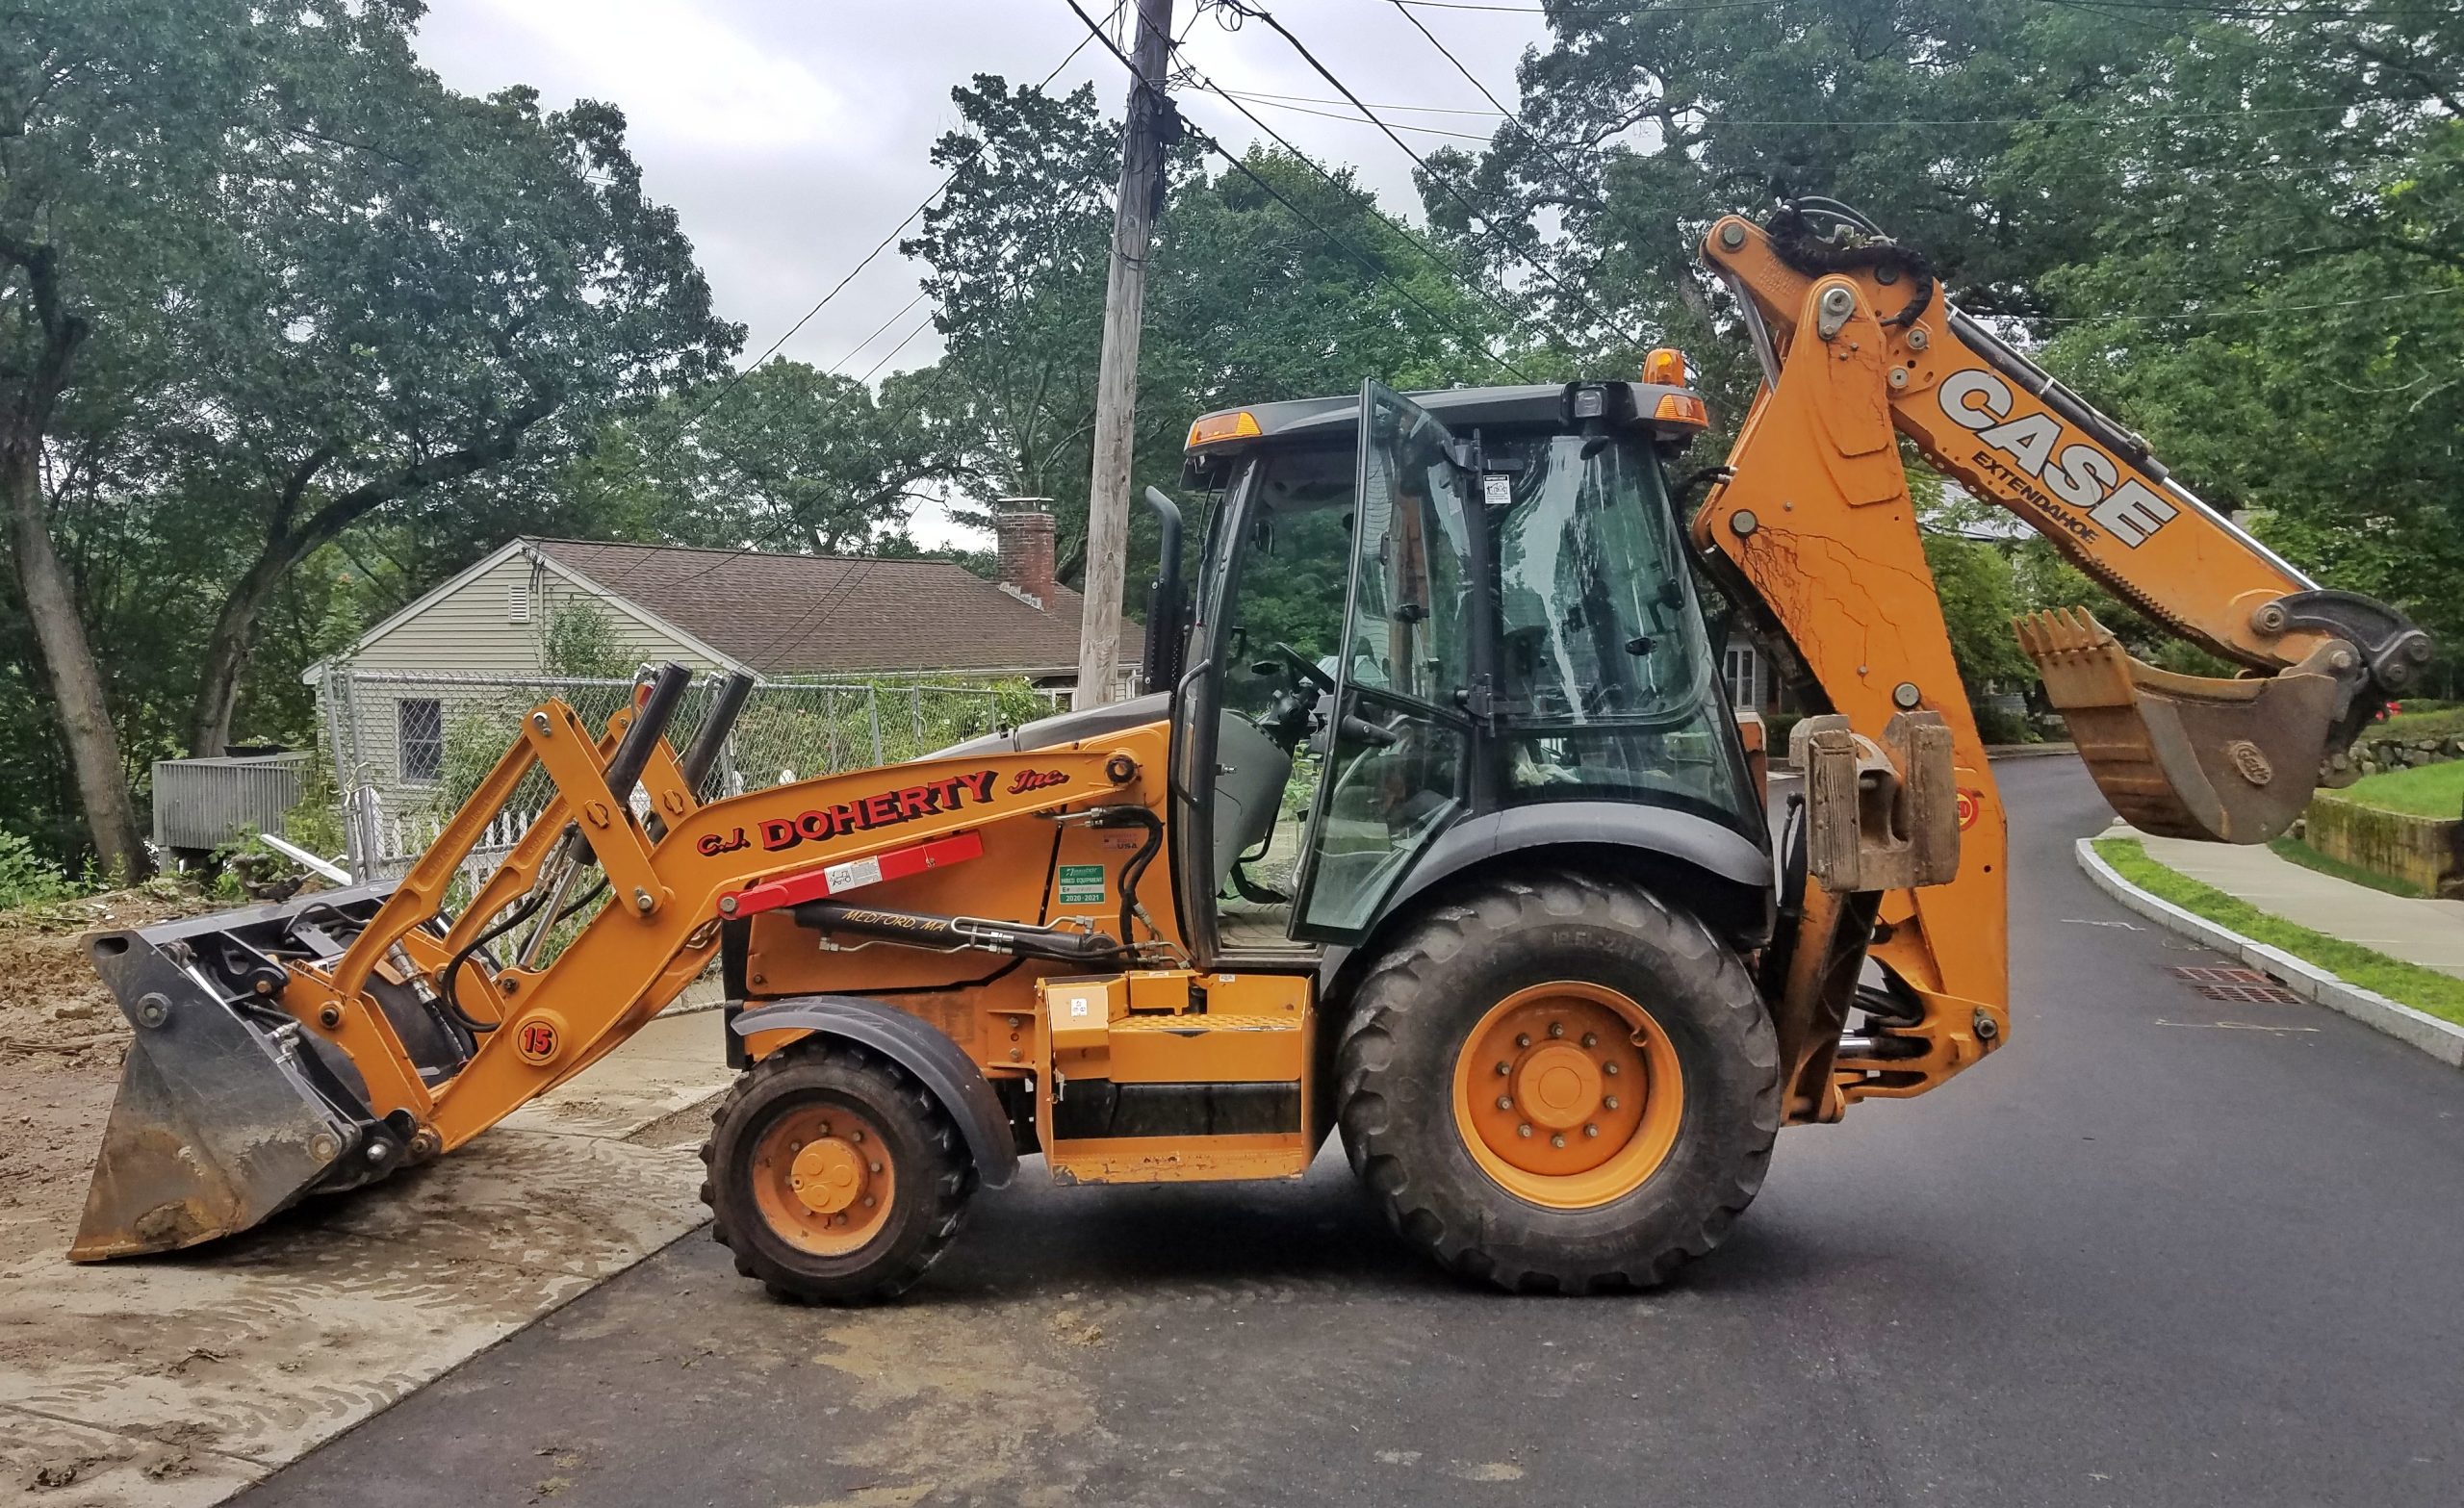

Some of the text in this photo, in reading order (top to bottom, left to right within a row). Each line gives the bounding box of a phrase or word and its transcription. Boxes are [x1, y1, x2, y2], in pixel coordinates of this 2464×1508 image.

[1938, 369, 2180, 550] CASE
[1972, 450, 2099, 545] EXTENDAHOE
[695, 767, 1070, 857] C.J. DOHERTY Inc.
[920, 920, 948, 932] MA
[524, 1026, 553, 1056] 15
